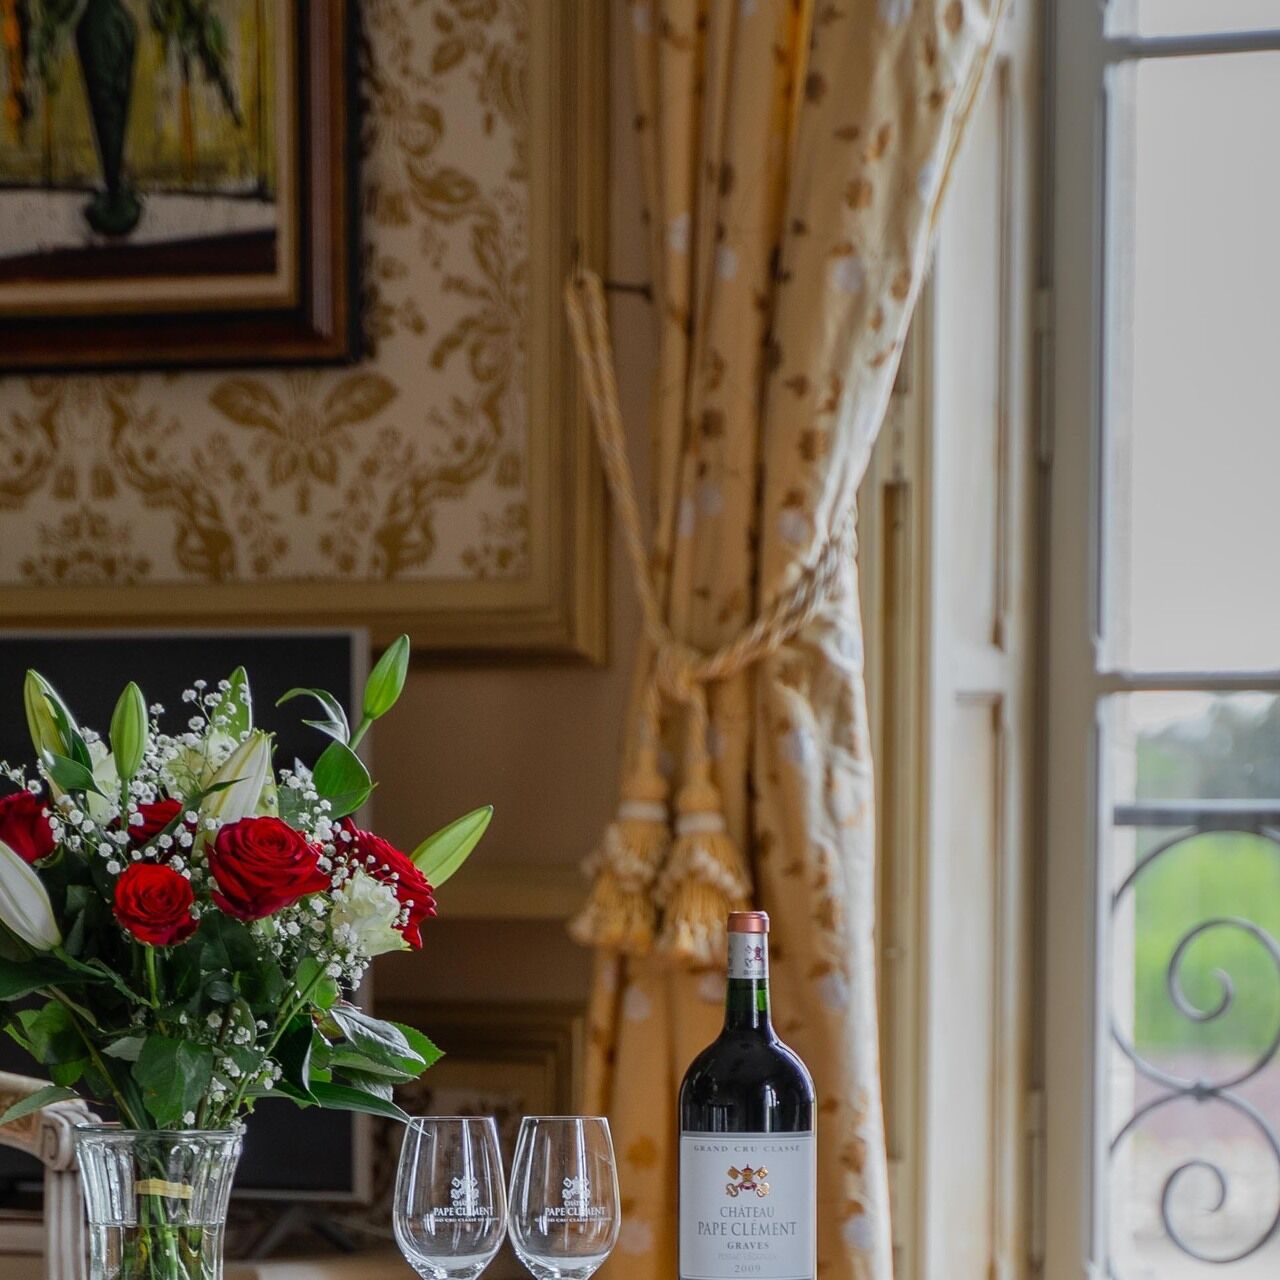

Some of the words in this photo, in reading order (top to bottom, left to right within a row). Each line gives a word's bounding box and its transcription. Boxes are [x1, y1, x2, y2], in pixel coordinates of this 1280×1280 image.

[693, 1144, 728, 1153] GRAND
[734, 1145, 758, 1153] CRU
[433, 1207, 454, 1216] PAPE
[545, 1207, 566, 1216] PAPE
[698, 1221, 727, 1236] PAPE
[731, 1219, 797, 1236] CLÉMENT
[727, 1242, 770, 1250] GRAVES
